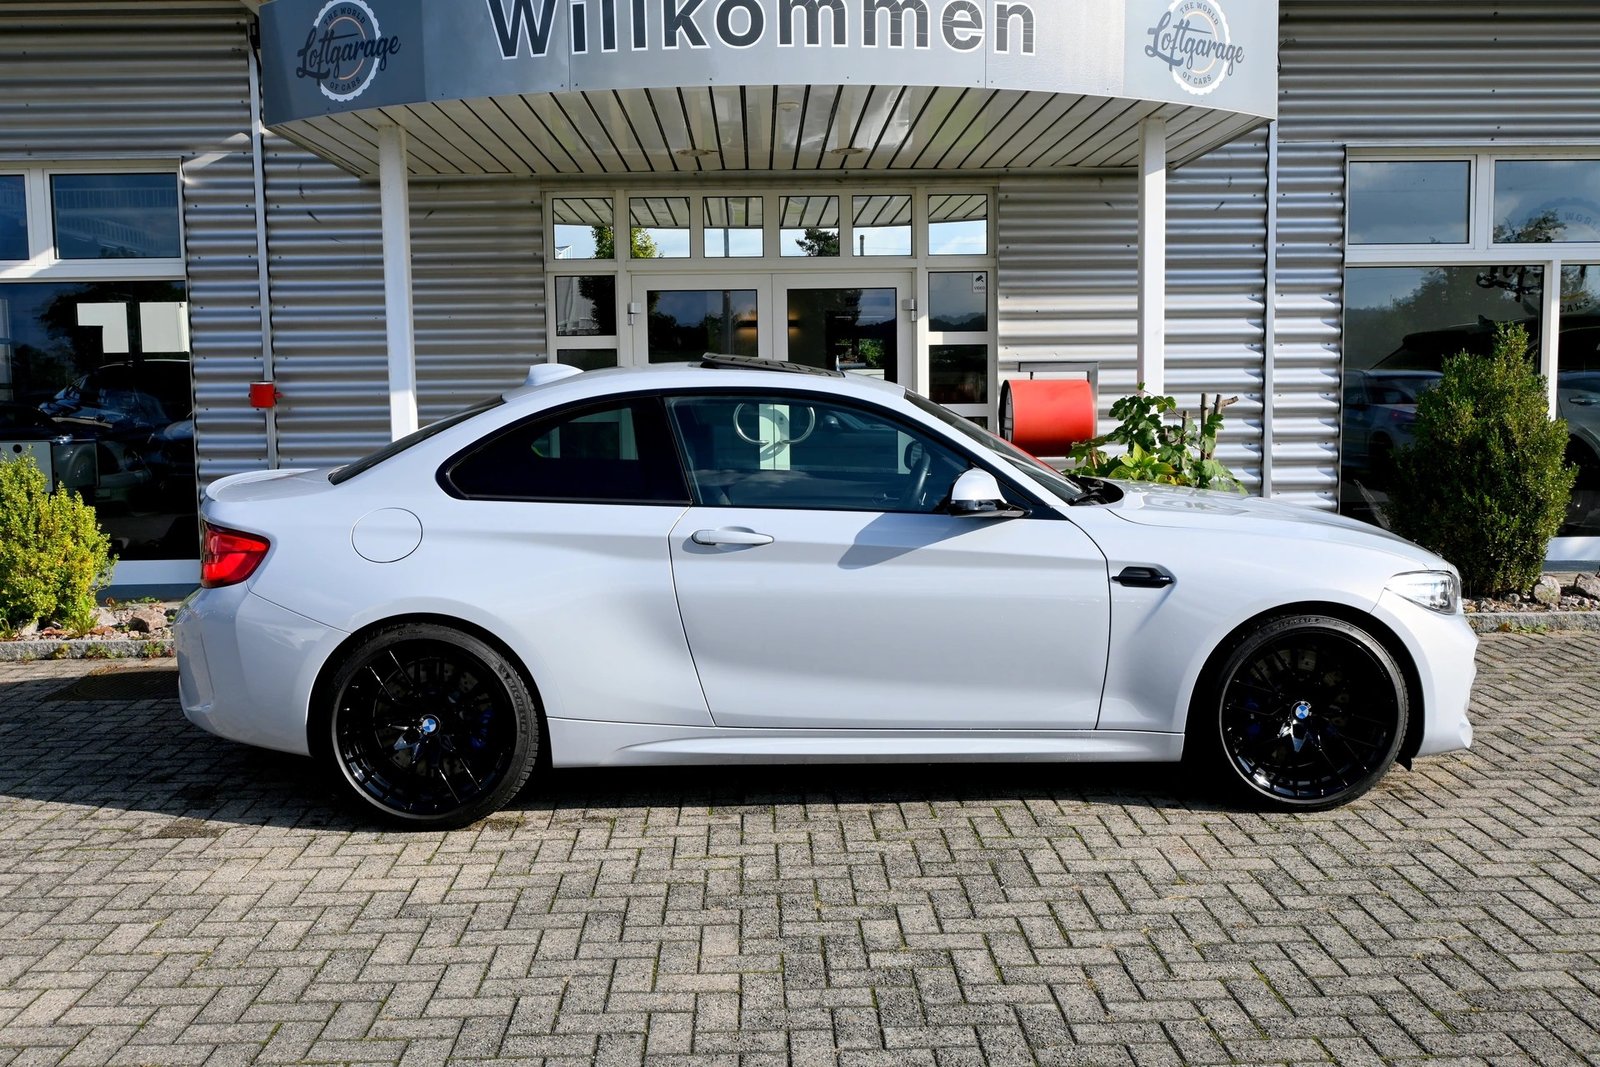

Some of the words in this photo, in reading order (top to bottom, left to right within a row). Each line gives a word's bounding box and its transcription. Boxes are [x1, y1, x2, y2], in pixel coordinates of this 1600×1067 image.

[341, 7, 366, 24] WORLD
[1180, 2, 1195, 15] THE
[1196, 2, 1219, 26] WORLD
[488, 0, 1036, 59] Willkommen
[1144, 11, 1245, 76] Loftgarage
[296, 26, 401, 87] Loftgarage
[329, 81, 339, 90] OF
[341, 77, 361, 91] CARS
[1182, 71, 1191, 82] OF
[1193, 74, 1212, 85] CARS
